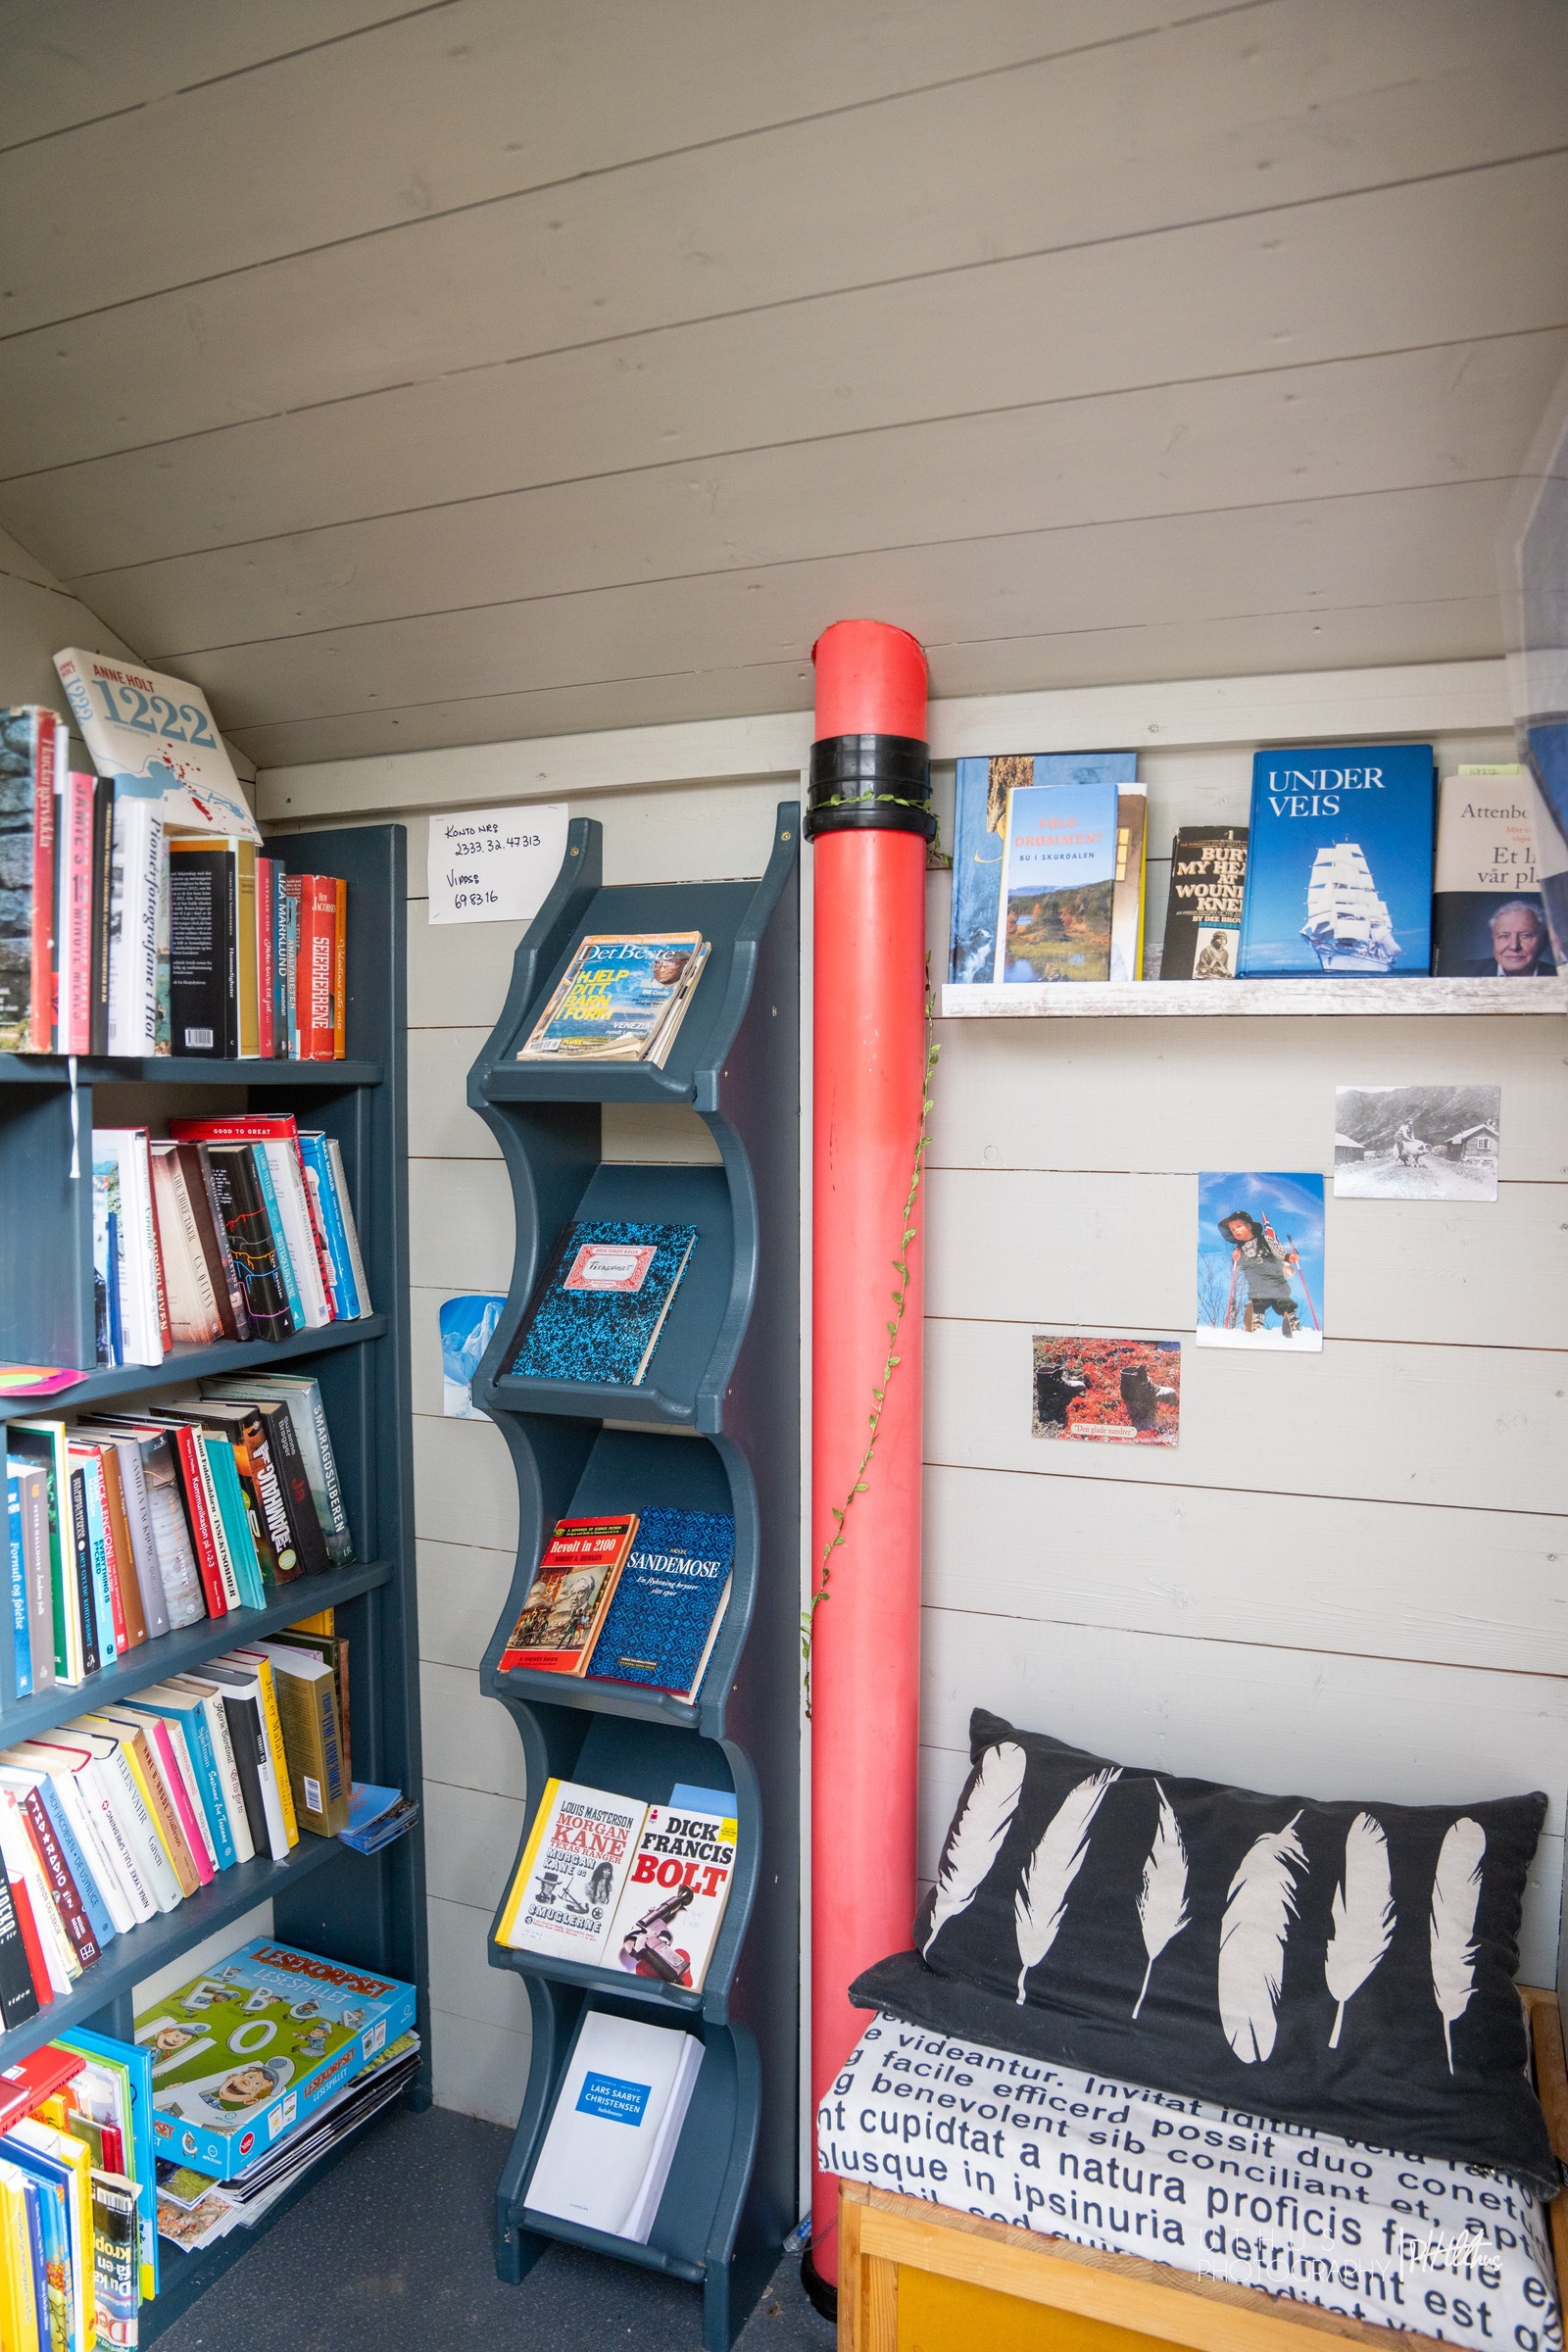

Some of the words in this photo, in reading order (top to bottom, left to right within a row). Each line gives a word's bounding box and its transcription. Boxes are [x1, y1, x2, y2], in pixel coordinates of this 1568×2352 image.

[93, 664, 125, 684] ANNE
[126, 674, 155, 694] HOLT
[66, 676, 93, 726] 1222
[91, 680, 218, 749] 1222
[35, 738, 54, 847] Hardangervidda
[1269, 767, 1386, 792] UNDER
[1269, 795, 1341, 817] VEIS
[1460, 804, 1527, 818] Attenbo
[73, 784, 89, 865] JAMIE'S
[445, 825, 475, 838] KONTO
[1039, 817, 1078, 829] FØLG
[1014, 832, 1102, 847] DRØMMEN!
[1041, 852, 1096, 861] SKURDALEN
[1177, 861, 1210, 875] MY
[1492, 847, 1517, 864] Et
[277, 872, 286, 899] LIZA
[1217, 874, 1238, 884] AT
[1478, 868, 1509, 883] vår
[140, 818, 161, 986] Pionérfotografane
[455, 891, 498, 909] 698316
[72, 908, 89, 964] MINUTE
[277, 904, 286, 976] MARKLUND
[335, 939, 344, 987] Valentinas
[578, 945, 617, 960] Det
[617, 945, 676, 960] Beste
[287, 939, 296, 1008] ANALFABETEN
[311, 936, 329, 1029] SEIERHERRENE
[577, 970, 630, 982] HJELP
[72, 971, 87, 1020] MEALS
[563, 995, 612, 1007] BARN
[570, 982, 607, 996] DITT
[262, 999, 271, 1013] jul
[563, 1007, 615, 1020] FORM
[319, 1140, 329, 1160] MAX
[172, 1173, 184, 1191] THE
[323, 1160, 335, 1192] MANUS
[175, 1191, 189, 1214] THIEF
[182, 1216, 196, 1243] TAKER
[296, 1189, 306, 1212] WHAT
[301, 1213, 314, 1252] MOTHERS
[309, 1252, 316, 1266] DO
[273, 1230, 296, 1299] SØSTERKLOKKENE
[195, 1273, 214, 1309] QUINN
[276, 1419, 291, 1456] Brøgger
[282, 1415, 296, 1455] Suzanne
[93, 1453, 107, 1500] PATRICK
[309, 1404, 347, 1532] SMARAGDSLIBEREN
[190, 1476, 209, 1539] Kommunikasjon
[255, 1462, 290, 1539] DAMHAUG
[195, 1434, 206, 1457] Knut
[201, 1458, 218, 1512] Faldbakken
[213, 1518, 235, 1597] INSEKTSOMMER
[99, 1503, 114, 1558] LENCIONI
[202, 1540, 210, 1548] på
[205, 1549, 215, 1567] 1-2-3
[550, 1541, 581, 1553] Revolt
[581, 1541, 592, 1552] in
[594, 1539, 616, 1551] 2100
[9, 1542, 22, 1582] Fornuft
[98, 1539, 109, 1593] EVERYTHING
[104, 1594, 110, 1603] IS
[627, 1552, 720, 1578] SANDEMOSE
[11, 1584, 20, 1595] og
[648, 1577, 675, 1589] flyktning
[676, 1582, 699, 1592] krysser
[12, 1598, 24, 1630] følelse
[264, 1680, 273, 1700] Jeg
[320, 1691, 332, 1714] FROM
[269, 1704, 276, 1716] er
[213, 1700, 227, 1730] Marie
[220, 1730, 235, 1764] Cardinal
[270, 1720, 283, 1760] Malala
[321, 1713, 336, 1740] TIME
[196, 1726, 212, 1768] Spielman
[323, 1740, 342, 1803] IMMEMORIAL
[47, 1791, 60, 1811] ROY
[114, 1753, 135, 1790] ELLEN
[128, 1789, 149, 1825] VAHR
[146, 1835, 165, 1866] Gaven
[140, 1745, 156, 1771] ANNE
[165, 1812, 184, 1846] Datteren
[214, 1802, 224, 1815] fra
[217, 1814, 230, 1843] Toscana
[557, 1813, 631, 1840] MORGAN
[561, 1800, 584, 1817] LOUIS
[585, 1806, 634, 1829] MASTERSON
[665, 1817, 719, 1841] DICK
[25, 1792, 47, 1833] PTSD
[44, 1842, 68, 1887] RADIO
[53, 1810, 76, 1853] JACOBSEN
[104, 1809, 126, 1850] SPREDNING
[551, 1824, 627, 1857] KANE
[121, 1848, 133, 1868] FULL
[546, 1847, 596, 1870] MORGAN
[551, 1839, 580, 1855] TEXAS
[581, 1848, 622, 1864] RANGER
[641, 1833, 733, 1864] FRANCIS
[72, 1856, 83, 1871] DE
[543, 1858, 575, 1876] KANE
[631, 1853, 728, 1897] BOLT
[77, 1869, 100, 1909] USYNLIGE
[128, 1868, 143, 1890] LYKKE
[137, 1888, 151, 1908] NINA
[527, 1903, 602, 1934] SMUGLERNE
[250, 1946, 397, 1999] LESEKORPSET
[253, 1968, 354, 2005] LESESPILLET
[48, 2068, 80, 2094] FAKTUM
[303, 2047, 357, 2099] LESEKORPSET
[313, 2069, 348, 2101] LESESPILLET
[899, 2033, 1064, 2087] videantur.
[1084, 2078, 1202, 2117] Invitat
[585, 2093, 640, 2113] CHRISTENSEN
[591, 2084, 611, 2095] LARS
[612, 2089, 641, 2103] SAABYE
[882, 2050, 973, 2087] facile
[994, 2085, 1130, 2123] efficerd
[1152, 2119, 1276, 2158] possit
[1298, 2145, 1373, 2180] duo
[872, 2074, 1070, 2138] benevolent
[1088, 2131, 1145, 2154] sib
[1167, 2149, 1370, 2206] conciliant
[1391, 2199, 1441, 2229] et,
[860, 2108, 1004, 2158] cupidtat
[1020, 2143, 1040, 2170] a
[1059, 2152, 1186, 2206] natura
[1207, 2185, 1361, 2245] proficis
[964, 2160, 995, 2195] in
[1014, 2174, 1185, 2246] ipsinuria
[1204, 2225, 1405, 2305] detriment
[1424, 2289, 1492, 2338] est
[98, 2256, 114, 2272] en
[117, 2264, 131, 2280] få
[110, 2278, 131, 2297] Du
